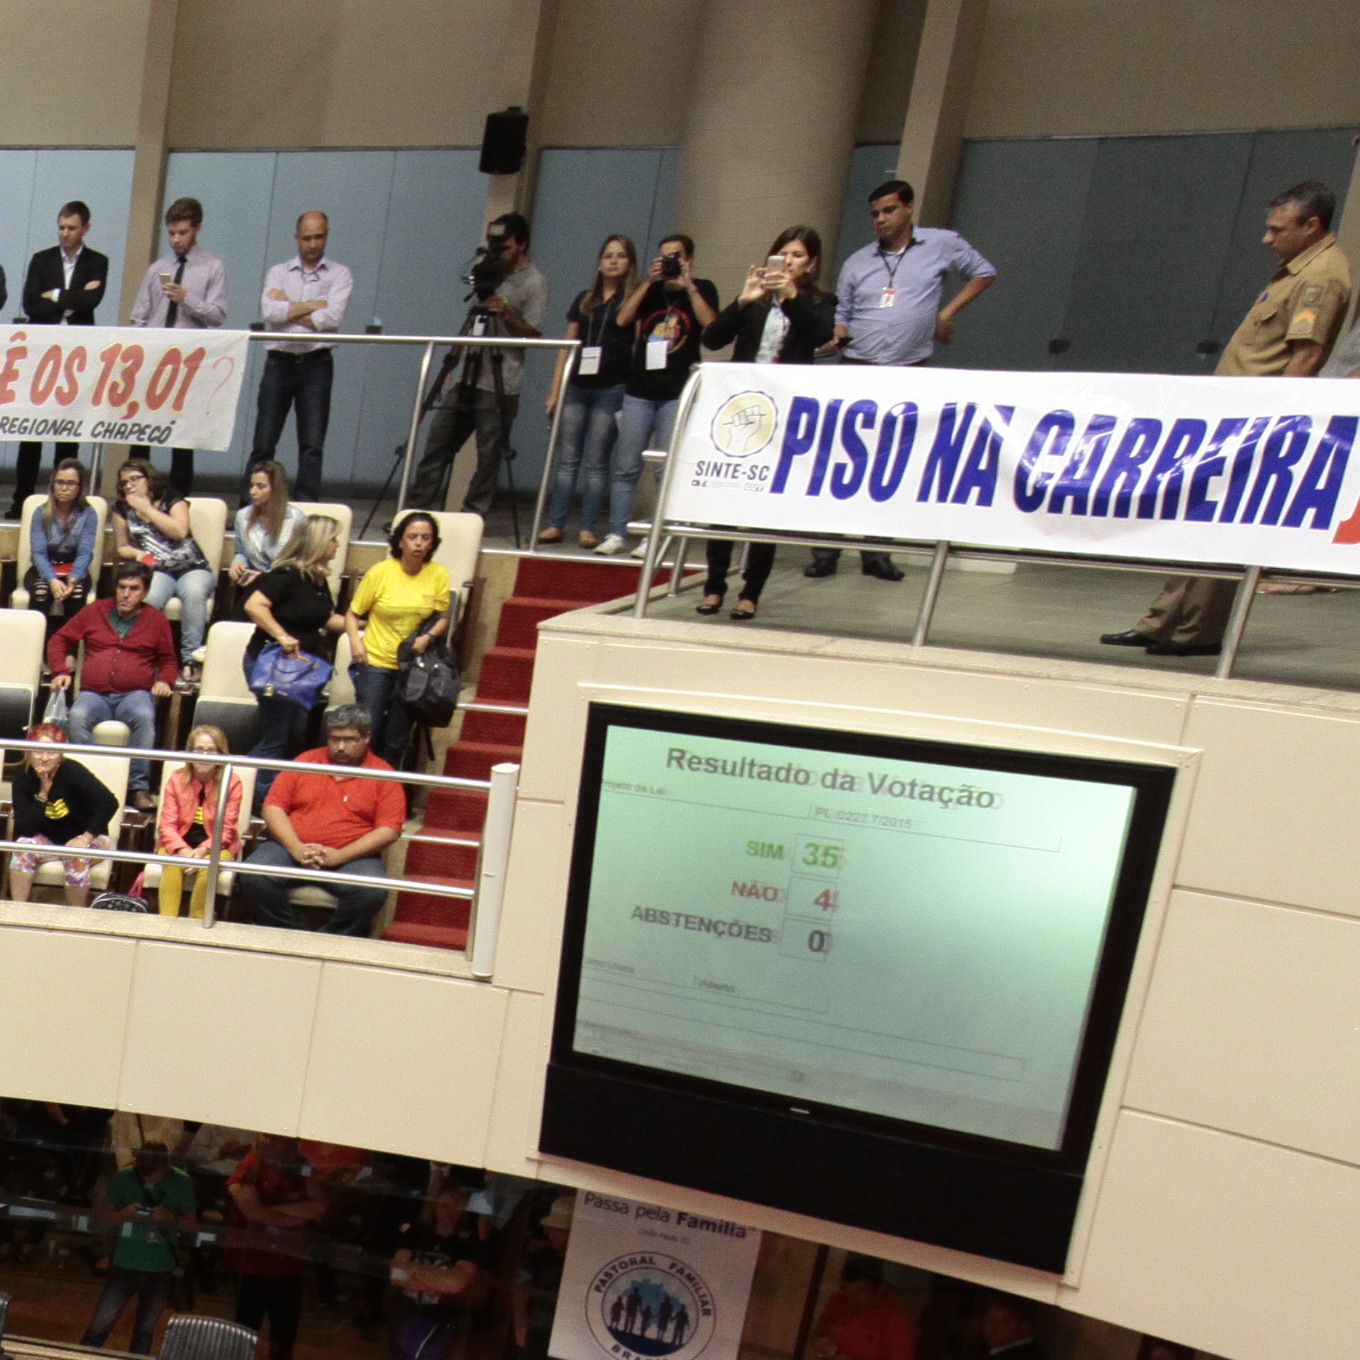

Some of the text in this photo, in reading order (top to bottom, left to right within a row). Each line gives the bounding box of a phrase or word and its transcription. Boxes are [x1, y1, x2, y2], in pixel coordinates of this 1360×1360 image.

[30, 345, 87, 406] OS
[90, 343, 206, 420] 13,01
[90, 419, 176, 444] CHAPECÓ
[695, 460, 770, 482] SINTE-SC
[769, 396, 918, 502] PISO
[917, 402, 1014, 507] NA
[1013, 409, 1360, 530] CARREIRA
[666, 747, 1000, 811] Resultado da Votação
[745, 839, 841, 869] SIM 35
[732, 880, 833, 912] NÃO 4
[631, 905, 826, 953] ABSTENÇÕES 0
[583, 1192, 629, 1215] Passa
[634, 1204, 671, 1223] pela
[594, 1256, 713, 1317] PASTORAL FAMILIAR
